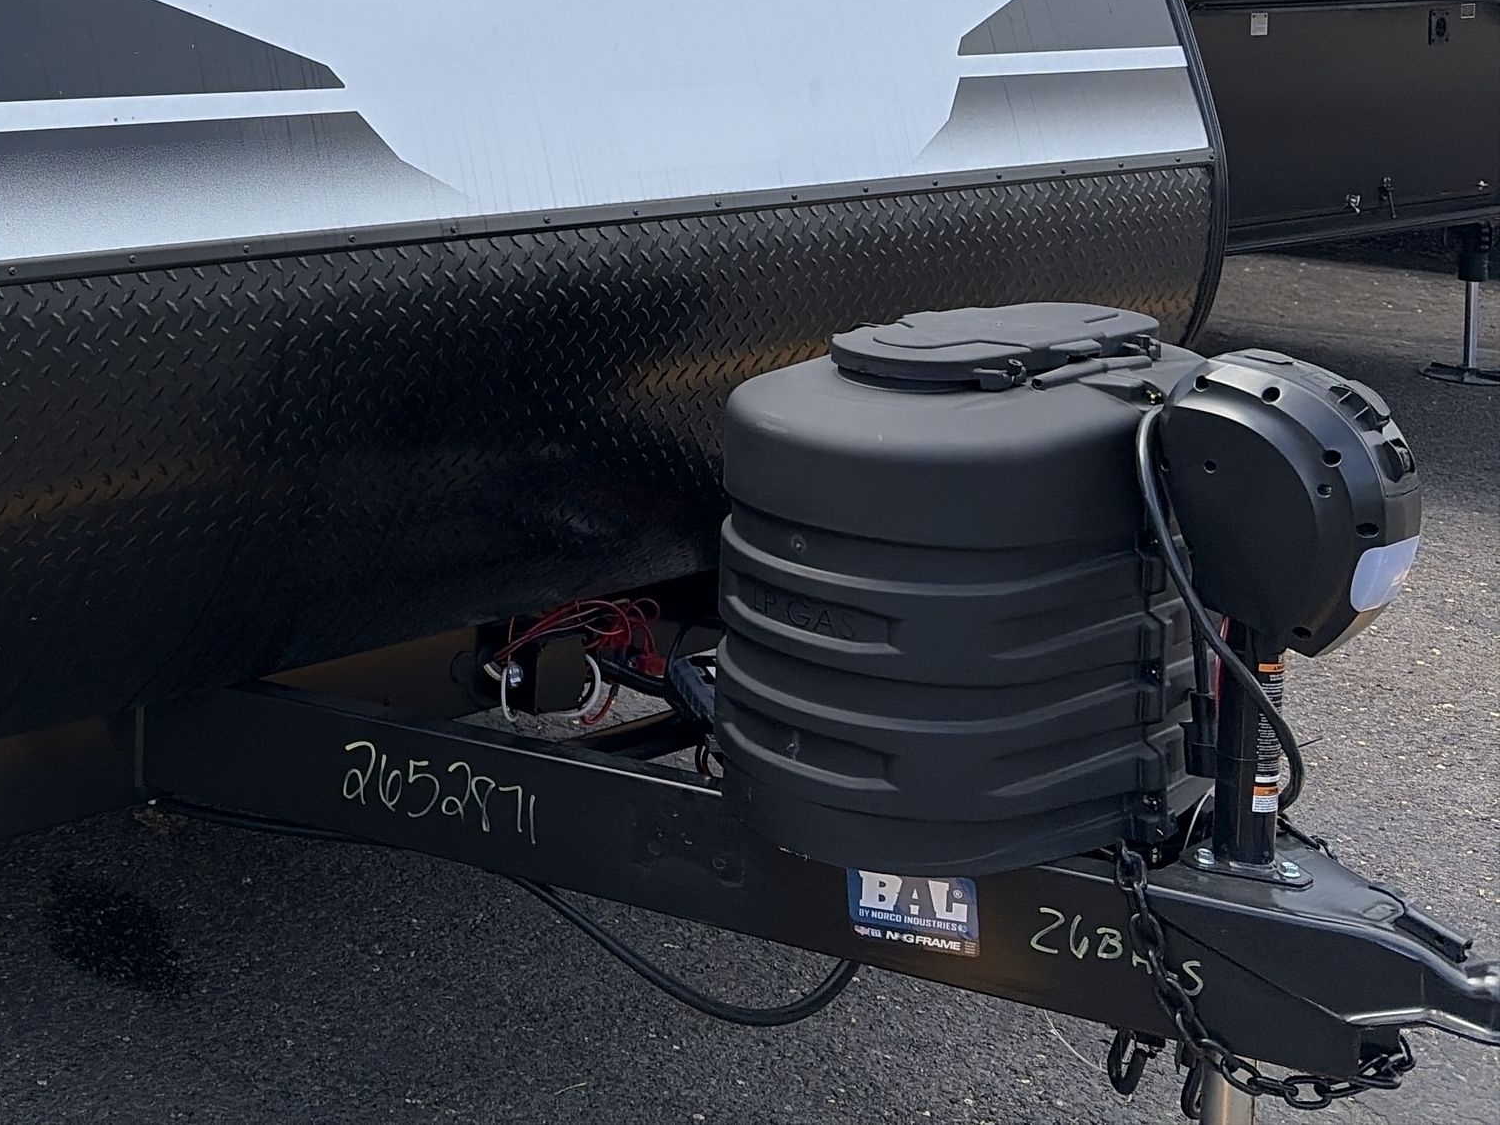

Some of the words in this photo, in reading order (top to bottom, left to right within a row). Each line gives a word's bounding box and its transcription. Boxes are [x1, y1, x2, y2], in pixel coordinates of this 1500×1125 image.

[787, 601, 855, 639] GAS
[343, 741, 536, 845] 2652871
[858, 870, 968, 923] BAL
[859, 908, 870, 918] BY
[871, 910, 902, 923] NORCO
[903, 915, 957, 932] INDUSTRIES
